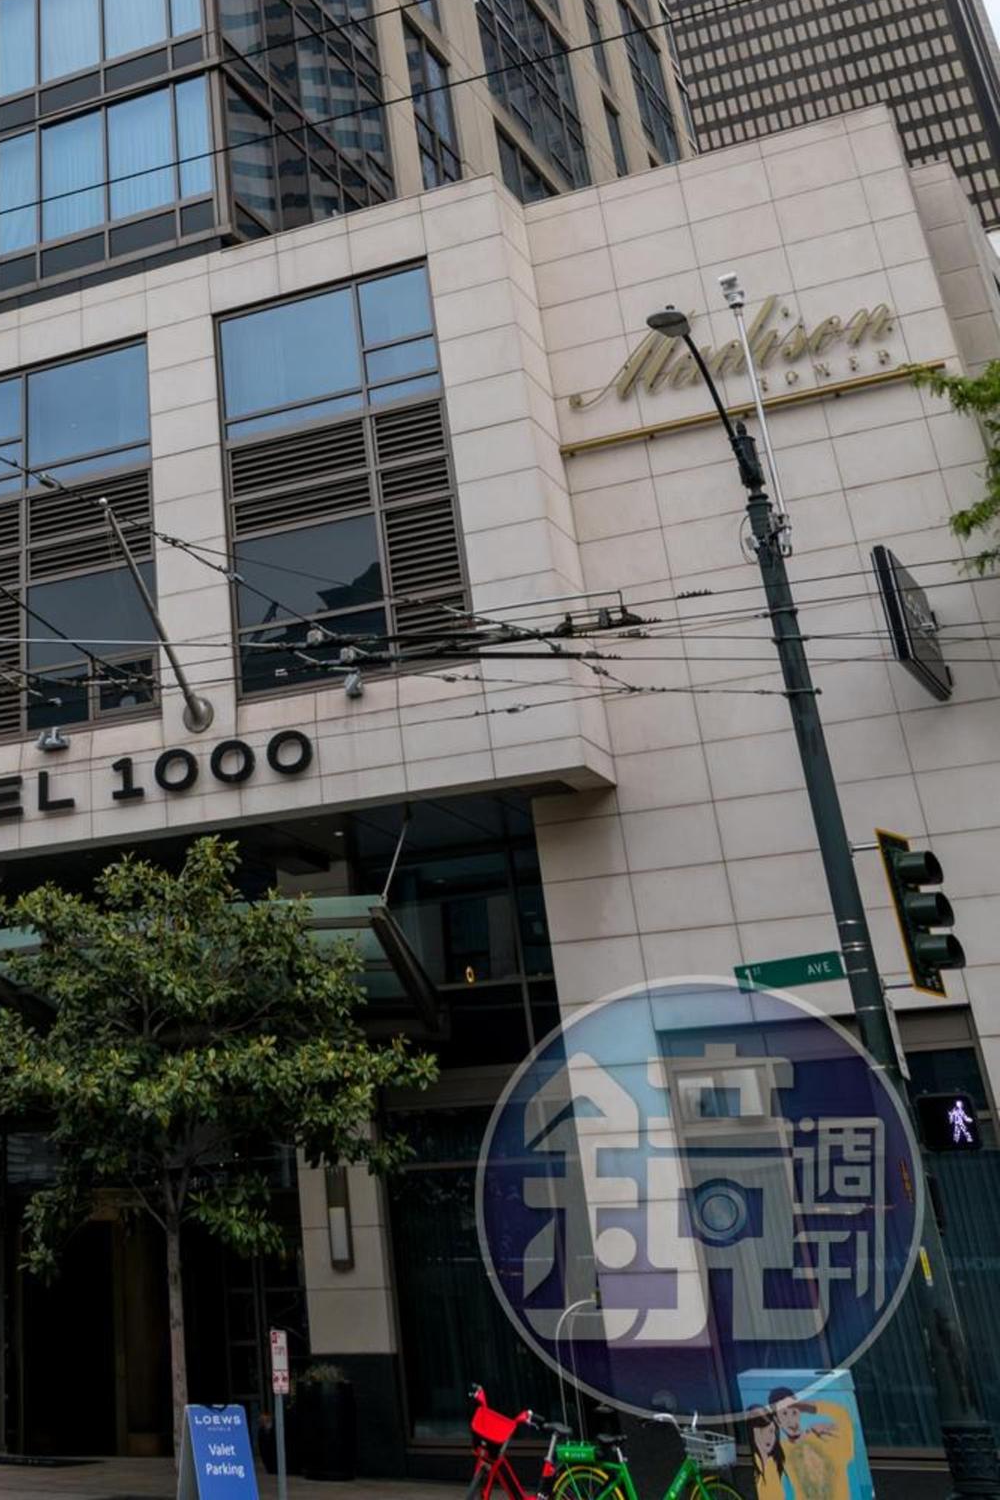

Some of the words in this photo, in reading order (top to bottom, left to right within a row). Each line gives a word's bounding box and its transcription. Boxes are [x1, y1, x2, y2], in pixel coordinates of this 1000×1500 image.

[568, 294, 892, 408] Madison
[111, 729, 313, 801] 1000
[807, 961, 833, 976] AVE
[194, 1415, 242, 1425] LOEWS
[208, 1443, 237, 1456] Valet
[205, 1463, 245, 1478] Parking
